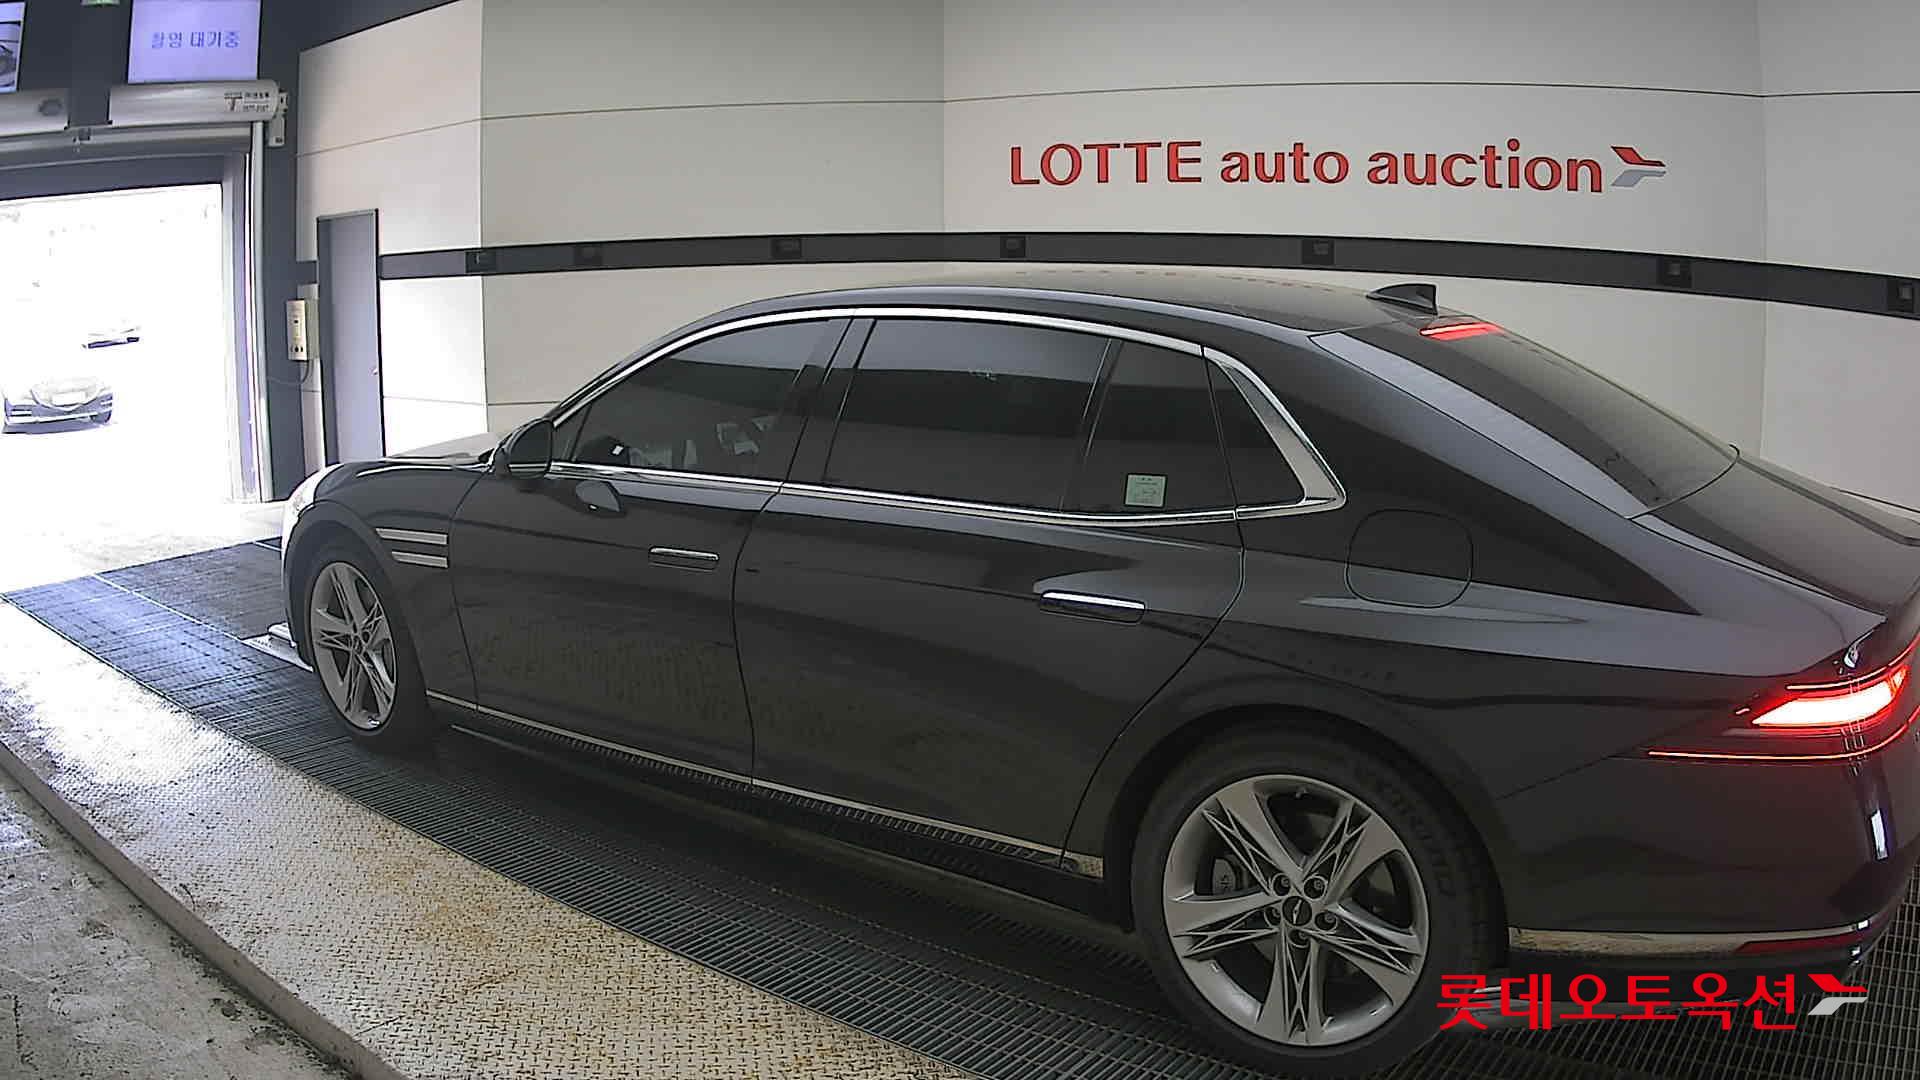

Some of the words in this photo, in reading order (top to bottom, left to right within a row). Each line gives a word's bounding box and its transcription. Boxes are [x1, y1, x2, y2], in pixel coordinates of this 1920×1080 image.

[190, 31, 240, 48] 대기중
[1011, 141, 1202, 186] LOTTE
[1220, 142, 1350, 184] auto
[1367, 138, 1603, 193] auction
